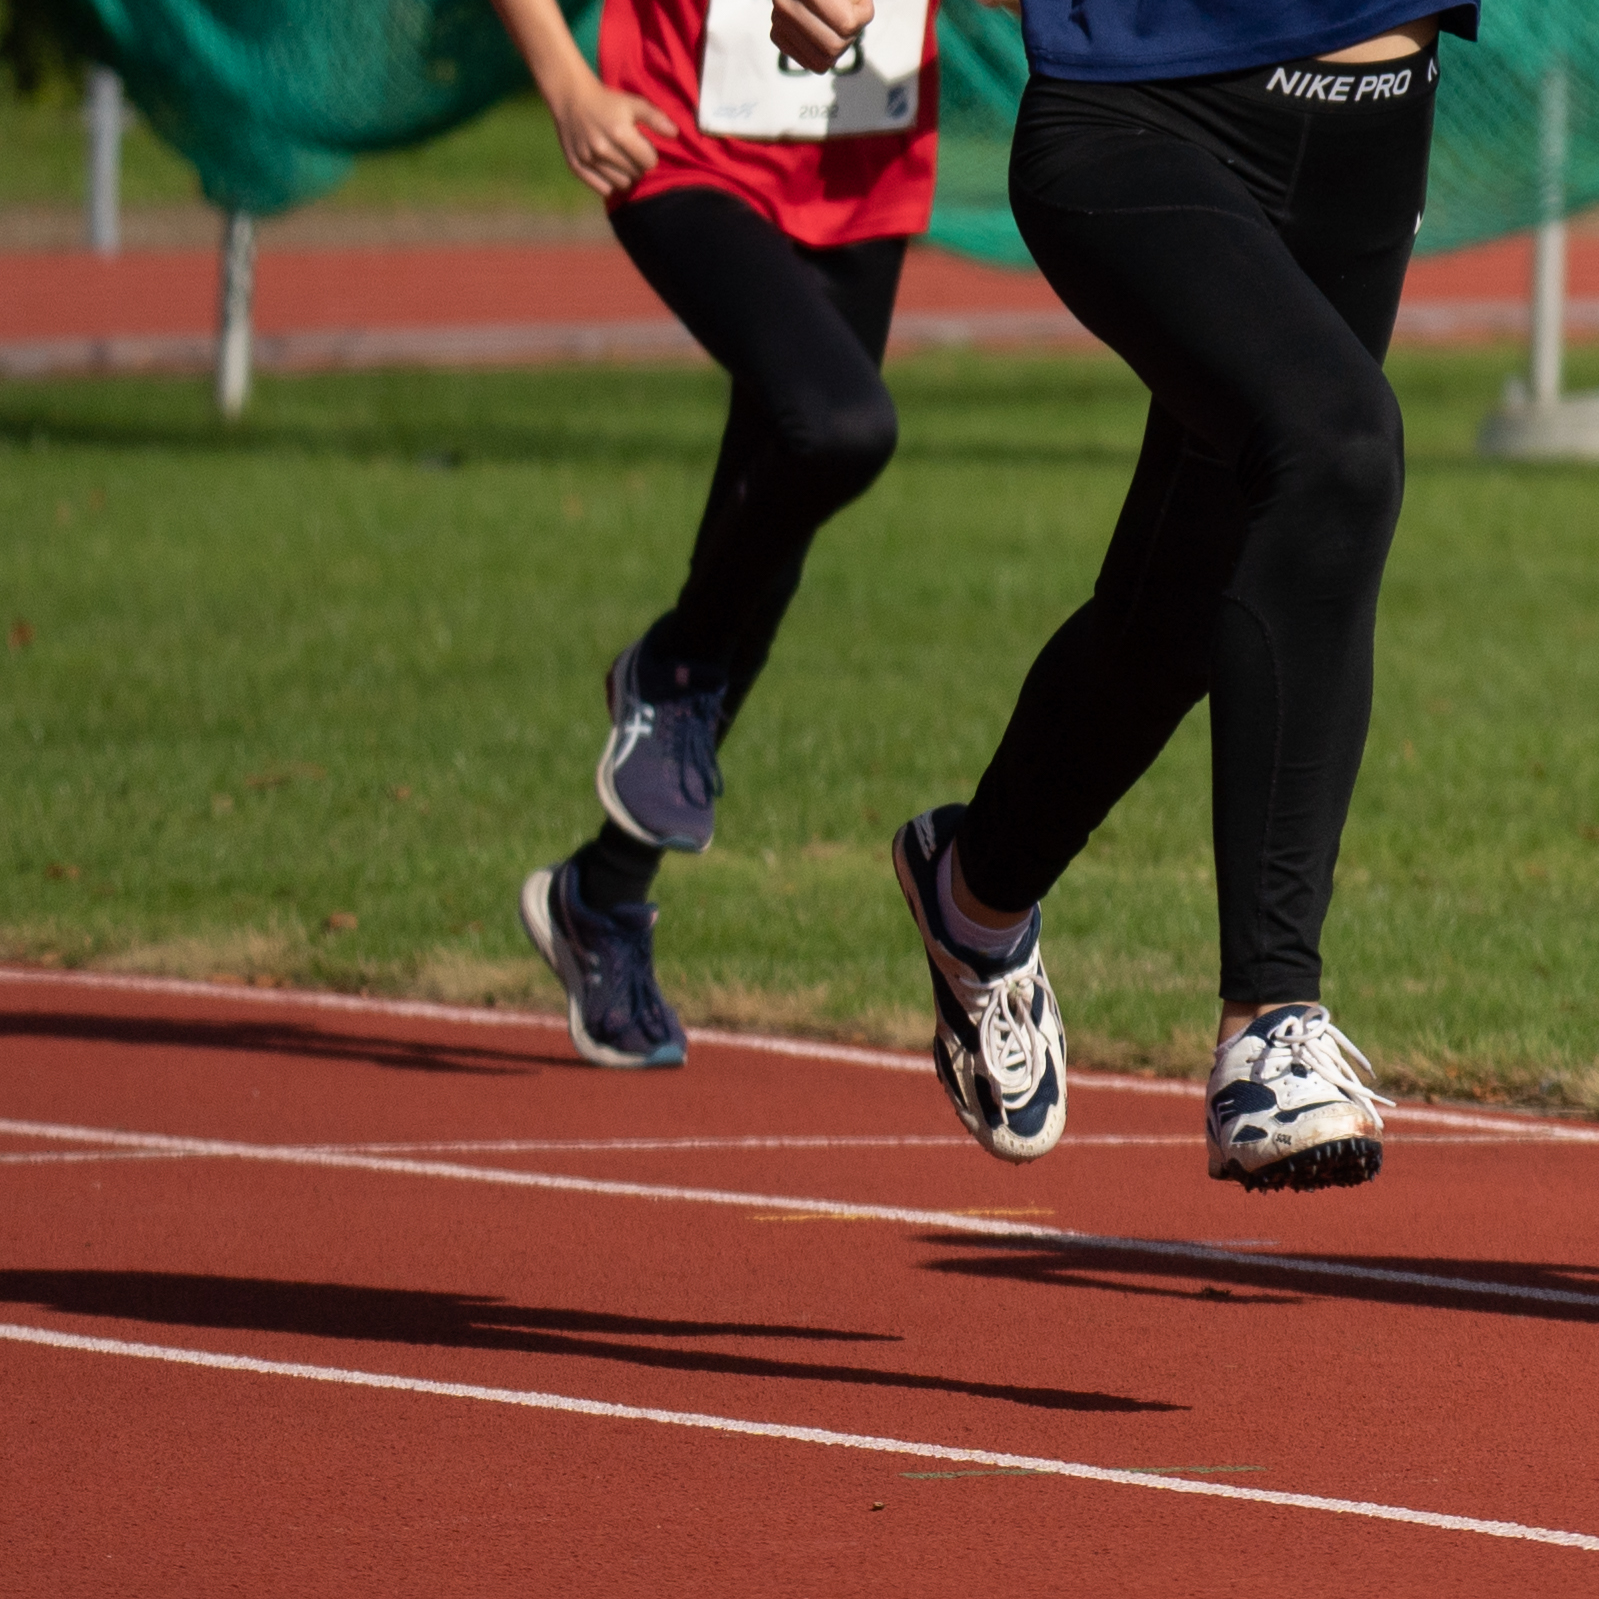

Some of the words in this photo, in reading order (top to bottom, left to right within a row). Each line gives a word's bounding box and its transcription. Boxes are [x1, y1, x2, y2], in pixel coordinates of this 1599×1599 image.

[1266, 67, 1355, 101] NIKE
[1355, 68, 1412, 102] PRO
[799, 105, 839, 120] 2022
